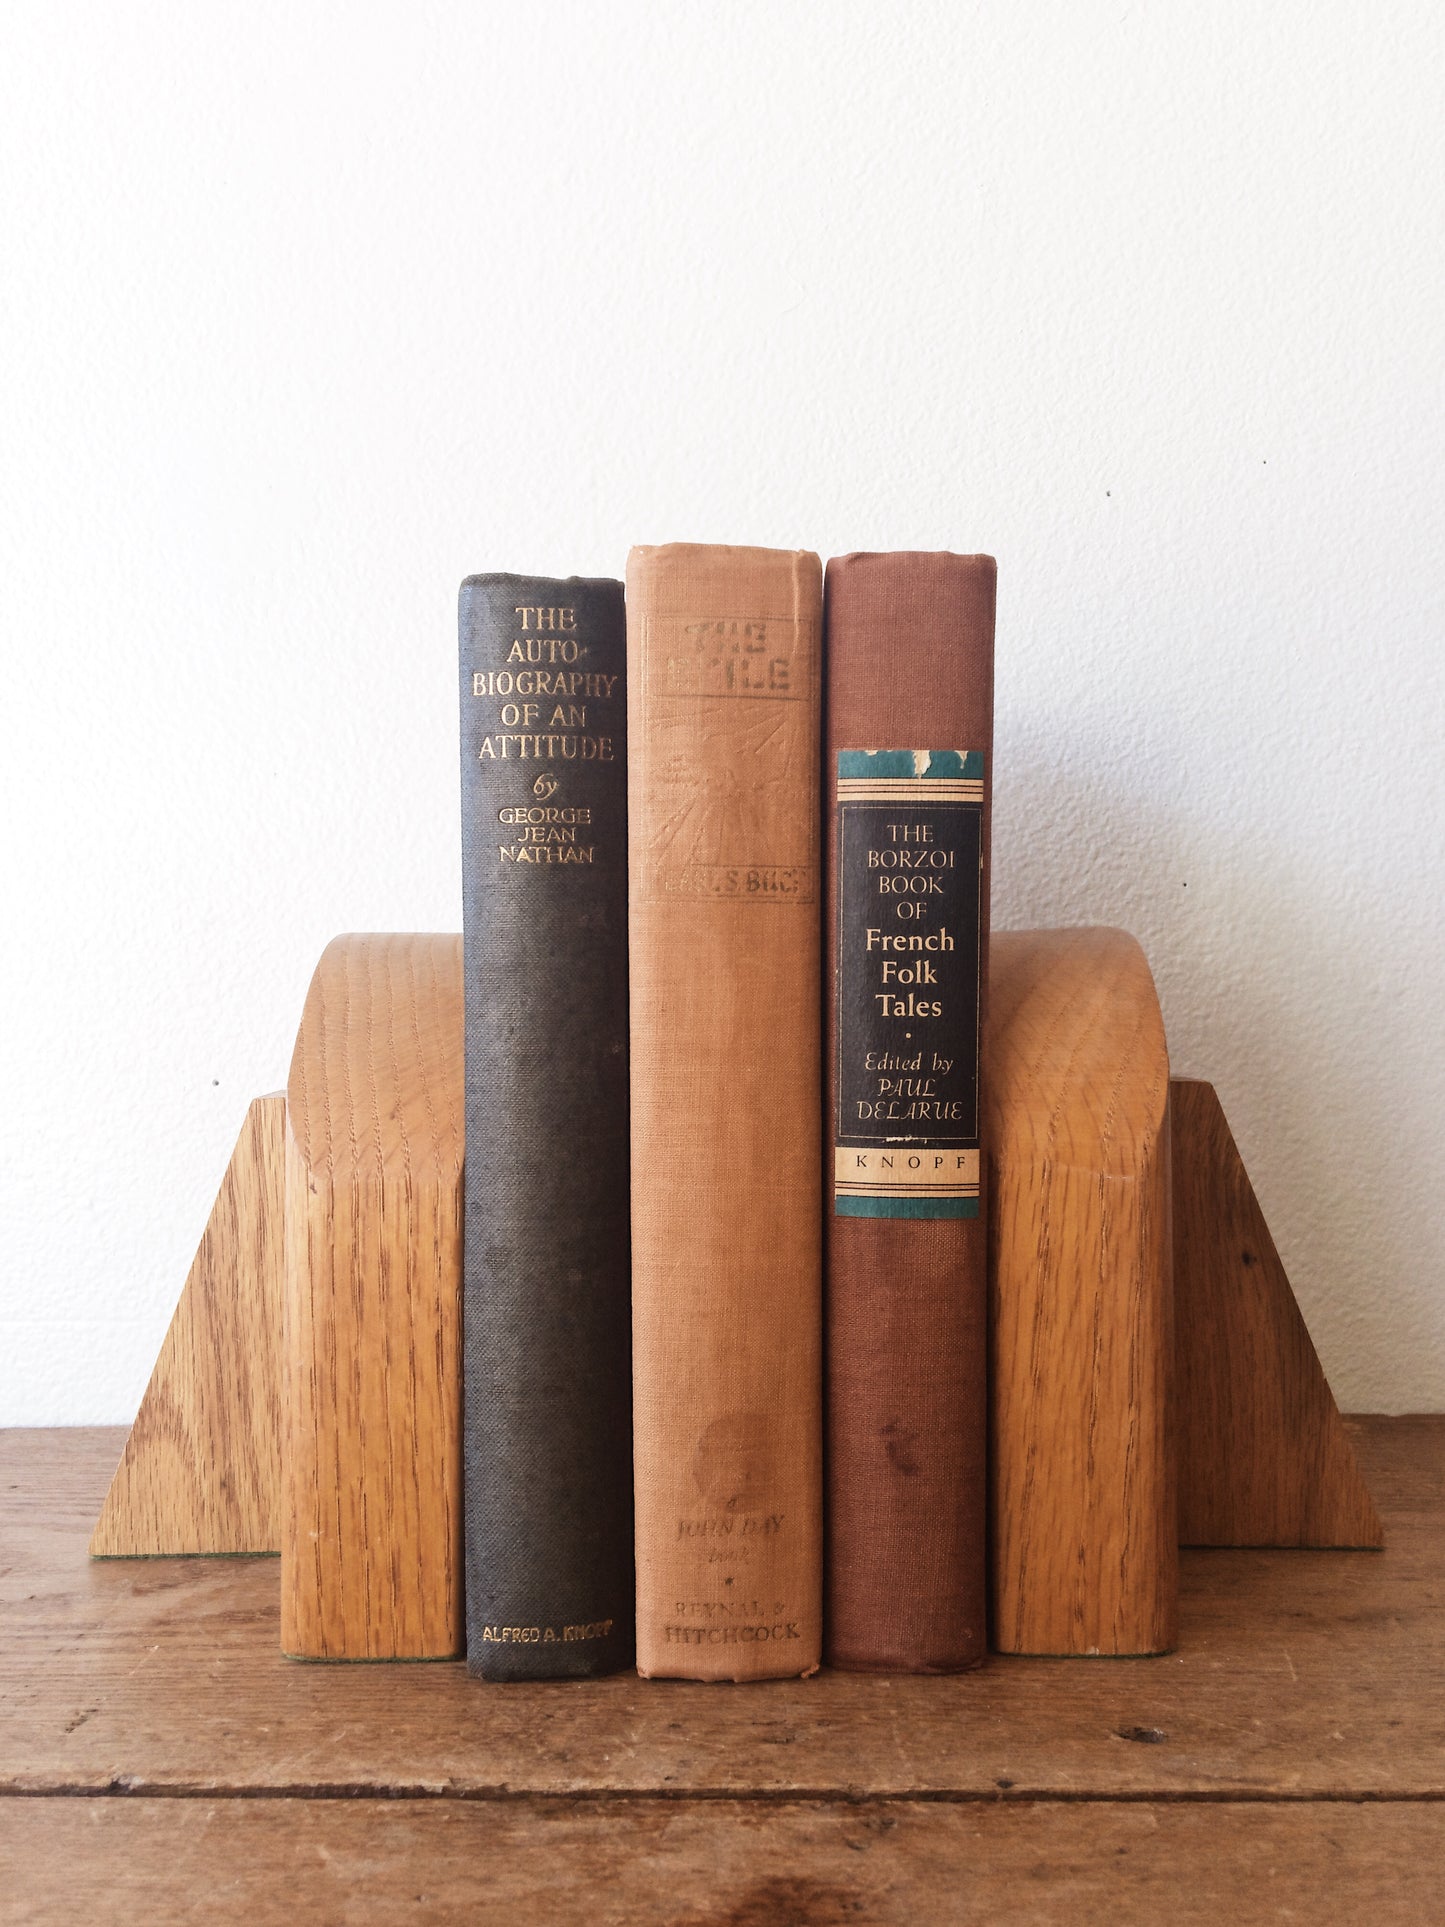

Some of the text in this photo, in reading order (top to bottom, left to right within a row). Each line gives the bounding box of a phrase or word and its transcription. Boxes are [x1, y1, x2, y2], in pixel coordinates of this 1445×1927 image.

[515, 607, 577, 630] THE
[472, 671, 618, 697] BIOGRAPHY
[501, 703, 588, 728] OF AN
[478, 735, 614, 761] ATTITUDE
[499, 807, 591, 825] GEORGE
[517, 827, 577, 843] JEAN
[887, 825, 934, 842] THE
[499, 846, 594, 864] NATHAN
[868, 850, 955, 868] BORZOI
[879, 876, 944, 894] BOOK
[896, 902, 928, 919] OF
[866, 927, 955, 951] French
[881, 959, 938, 984] Folk
[875, 993, 942, 1017] Tales
[865, 1052, 954, 1075] Edited by
[877, 1078, 936, 1097] PAUL
[856, 1101, 962, 1120] DELARUE
[856, 1155, 966, 1169] KNOPF
[482, 1619, 613, 1643] ALFRED A. KNOPF
[664, 1623, 800, 1644] HITCHCOCK
